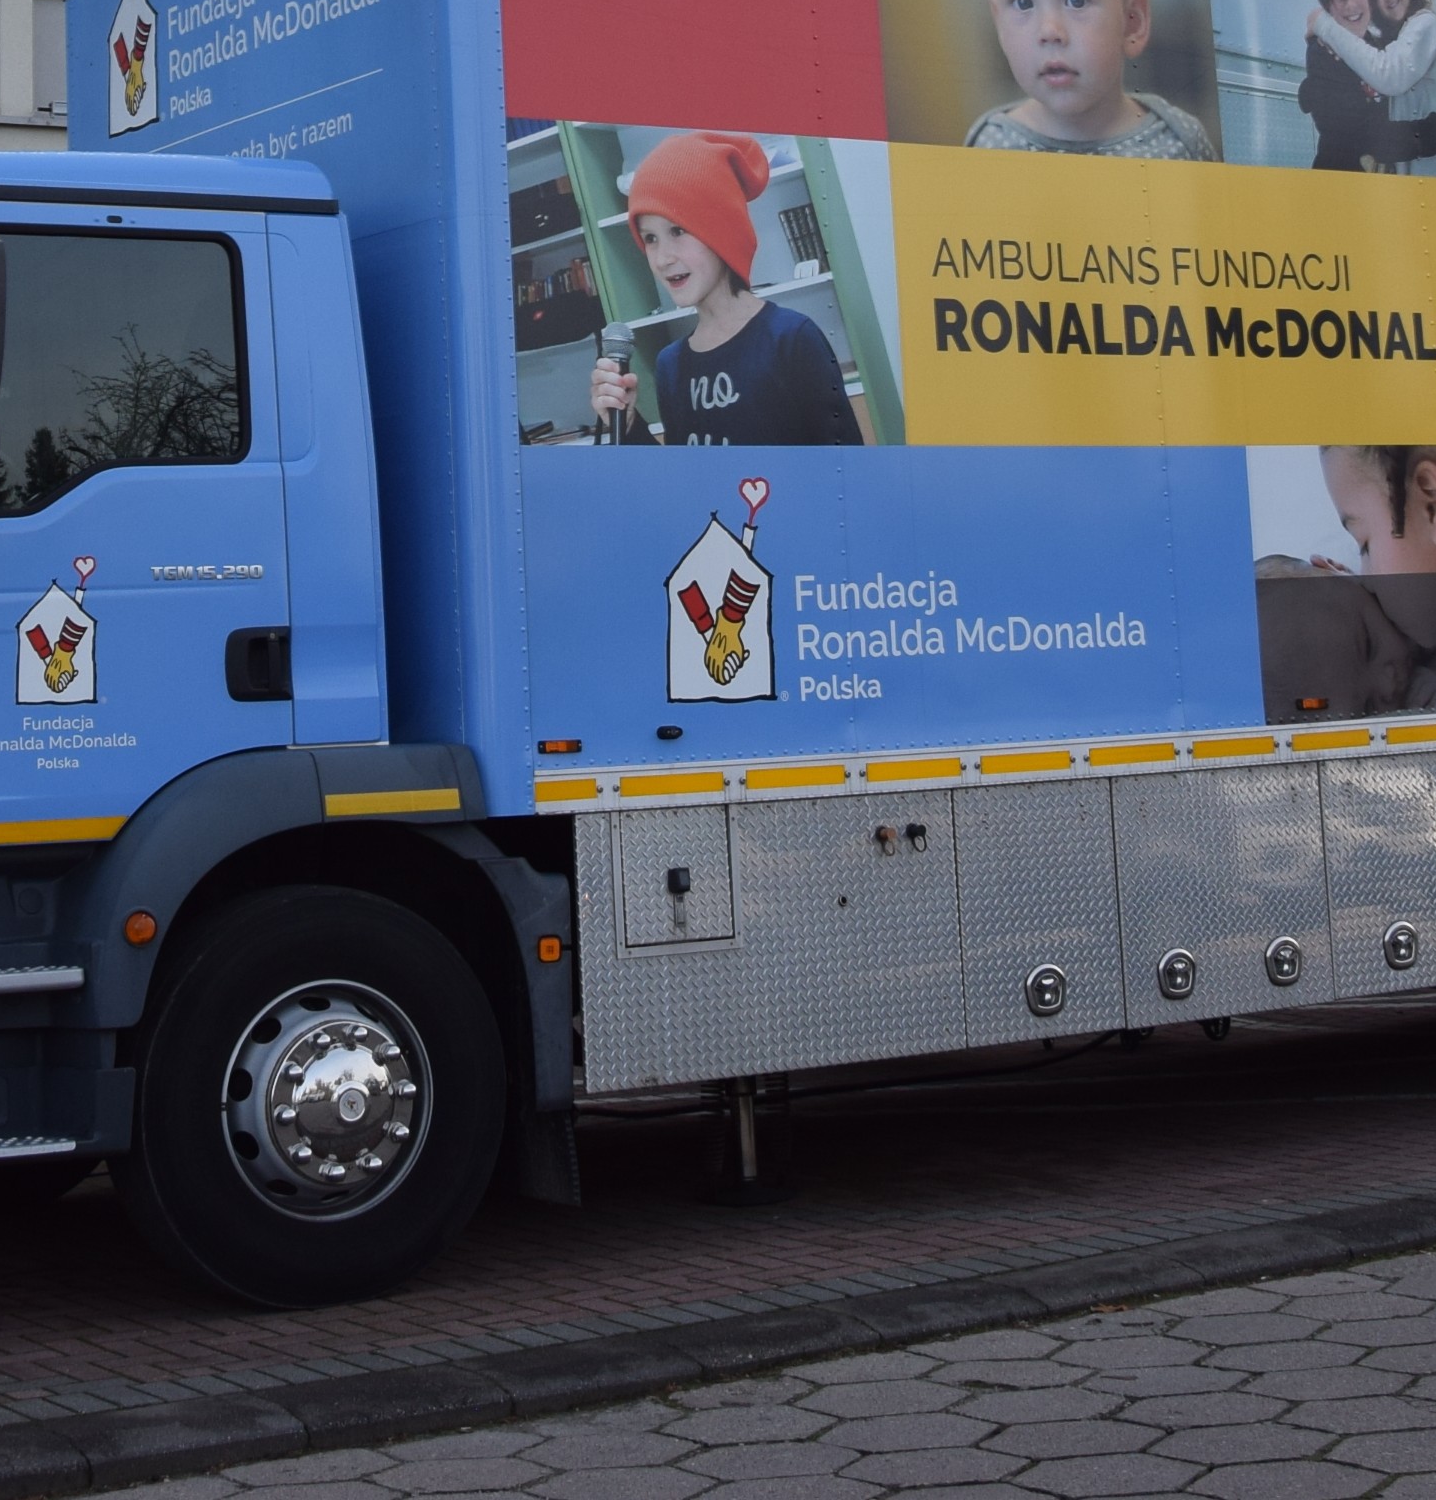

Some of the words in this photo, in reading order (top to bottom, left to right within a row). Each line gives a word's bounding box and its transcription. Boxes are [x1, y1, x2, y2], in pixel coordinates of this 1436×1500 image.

[168, 23, 247, 83] Ronalda
[169, 85, 212, 120] Polska
[269, 125, 298, 160] być
[302, 112, 352, 147] razem
[931, 236, 1161, 286] AMBULANS
[1170, 246, 1351, 293] FUNDACJI
[932, 297, 1196, 358] RONALDA
[150, 565, 194, 581] TGM
[196, 564, 264, 580] 15.290
[794, 570, 959, 617] Fundacja
[796, 619, 945, 661] Ronalda
[956, 611, 1147, 654] McDonalda
[799, 673, 882, 702] Polska
[22, 714, 95, 733] Fundacja
[48, 732, 137, 750] McDonalda
[36, 755, 80, 770] Polska
